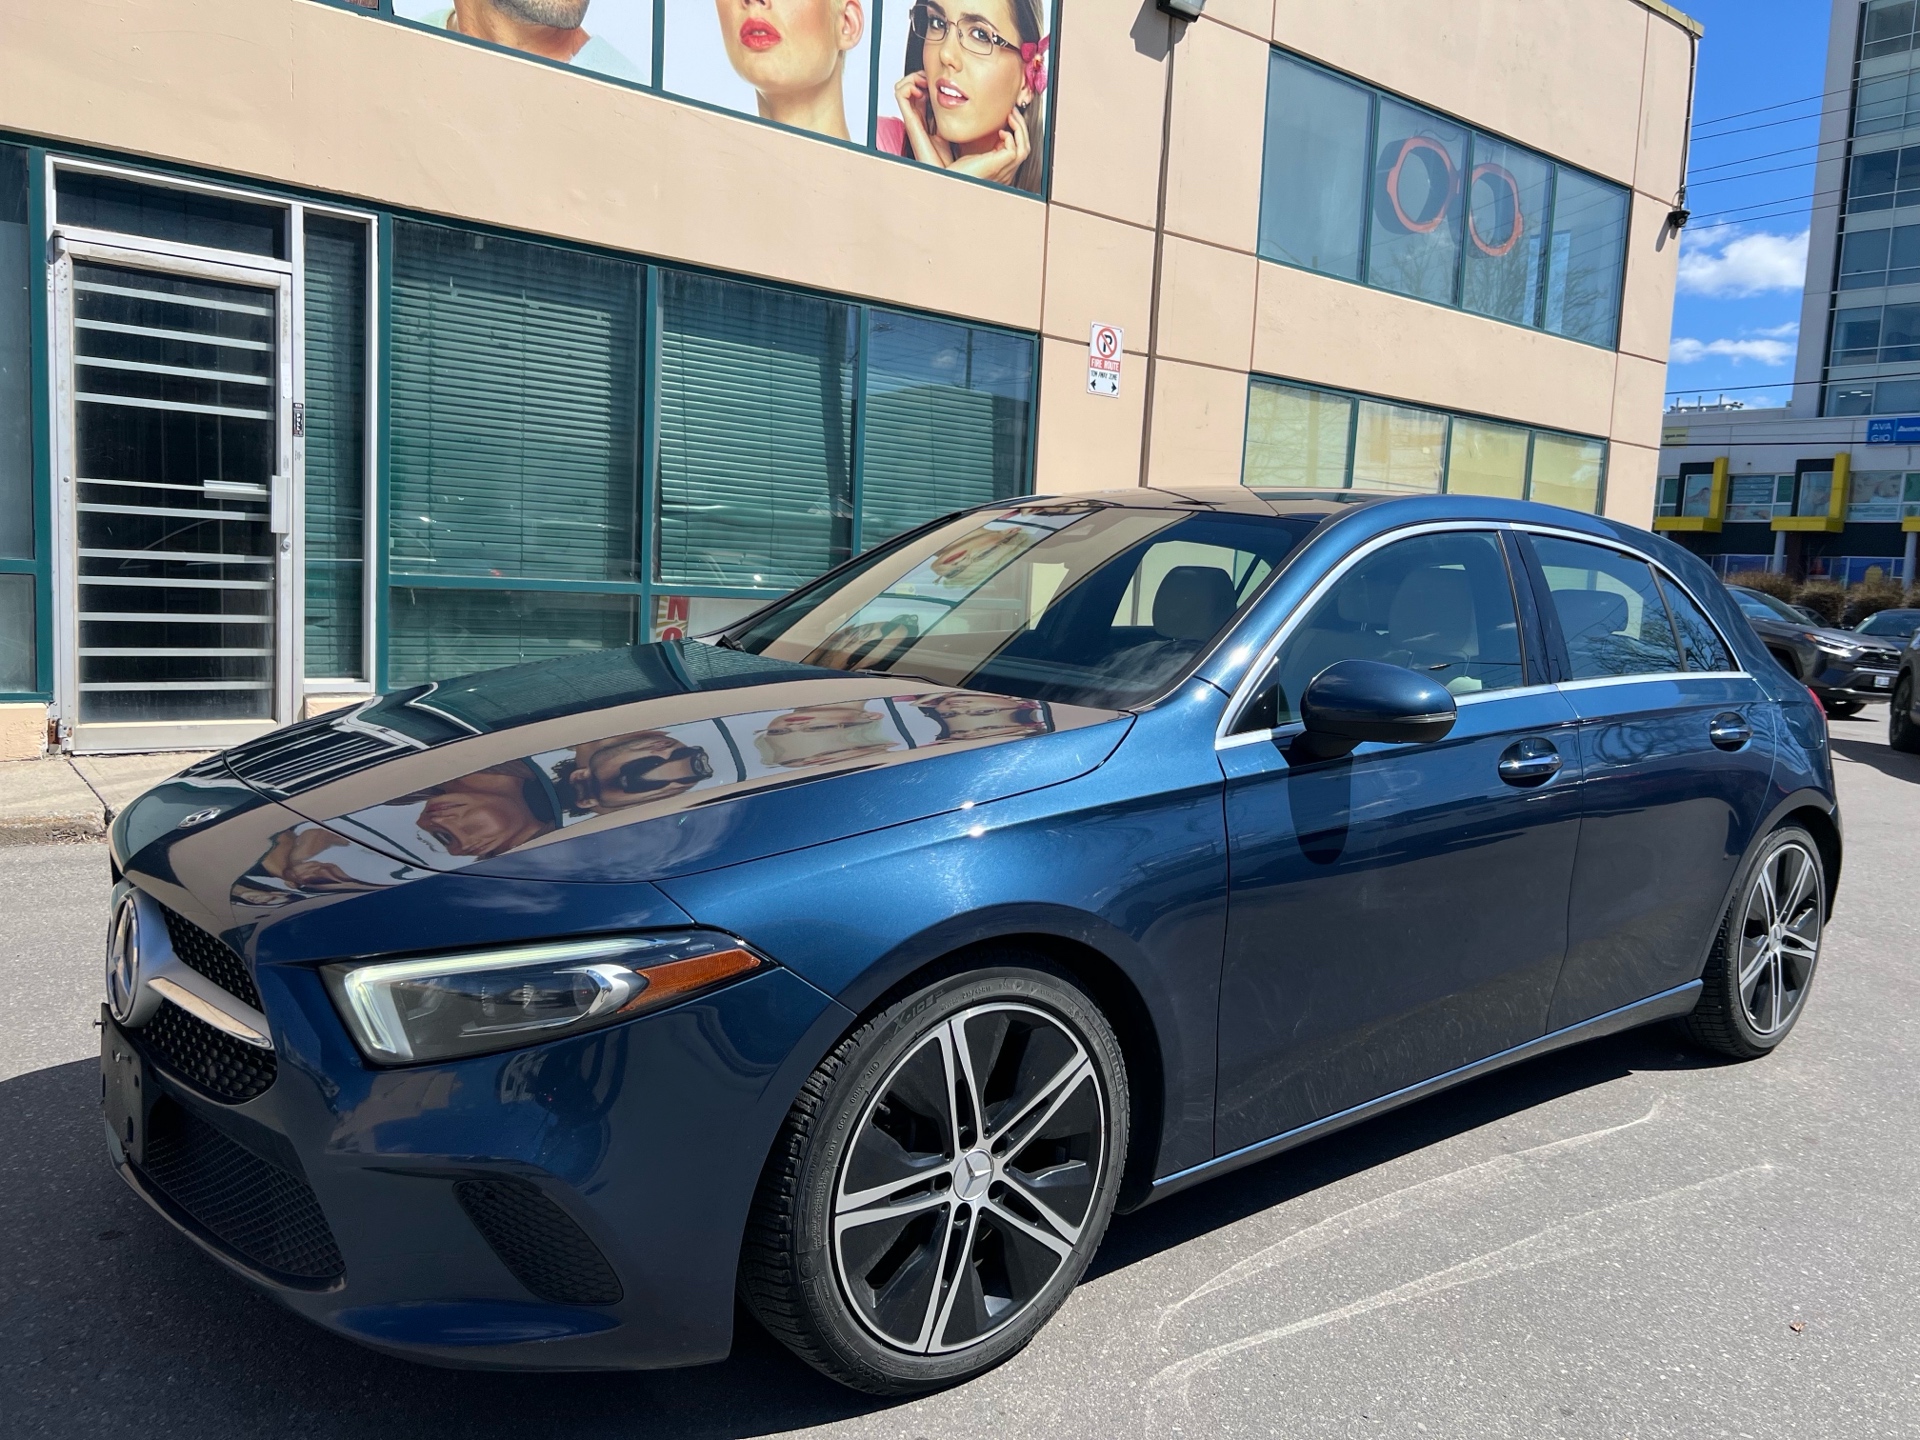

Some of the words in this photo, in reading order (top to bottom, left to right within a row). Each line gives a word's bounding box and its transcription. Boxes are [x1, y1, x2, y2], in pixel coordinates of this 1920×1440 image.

[1091, 357, 1102, 369] FIRE
[1104, 360, 1119, 371] ROUTE
[1098, 371, 1108, 379] AWAY
[1109, 373, 1117, 381] ZONE
[1872, 422, 1892, 431] AVA
